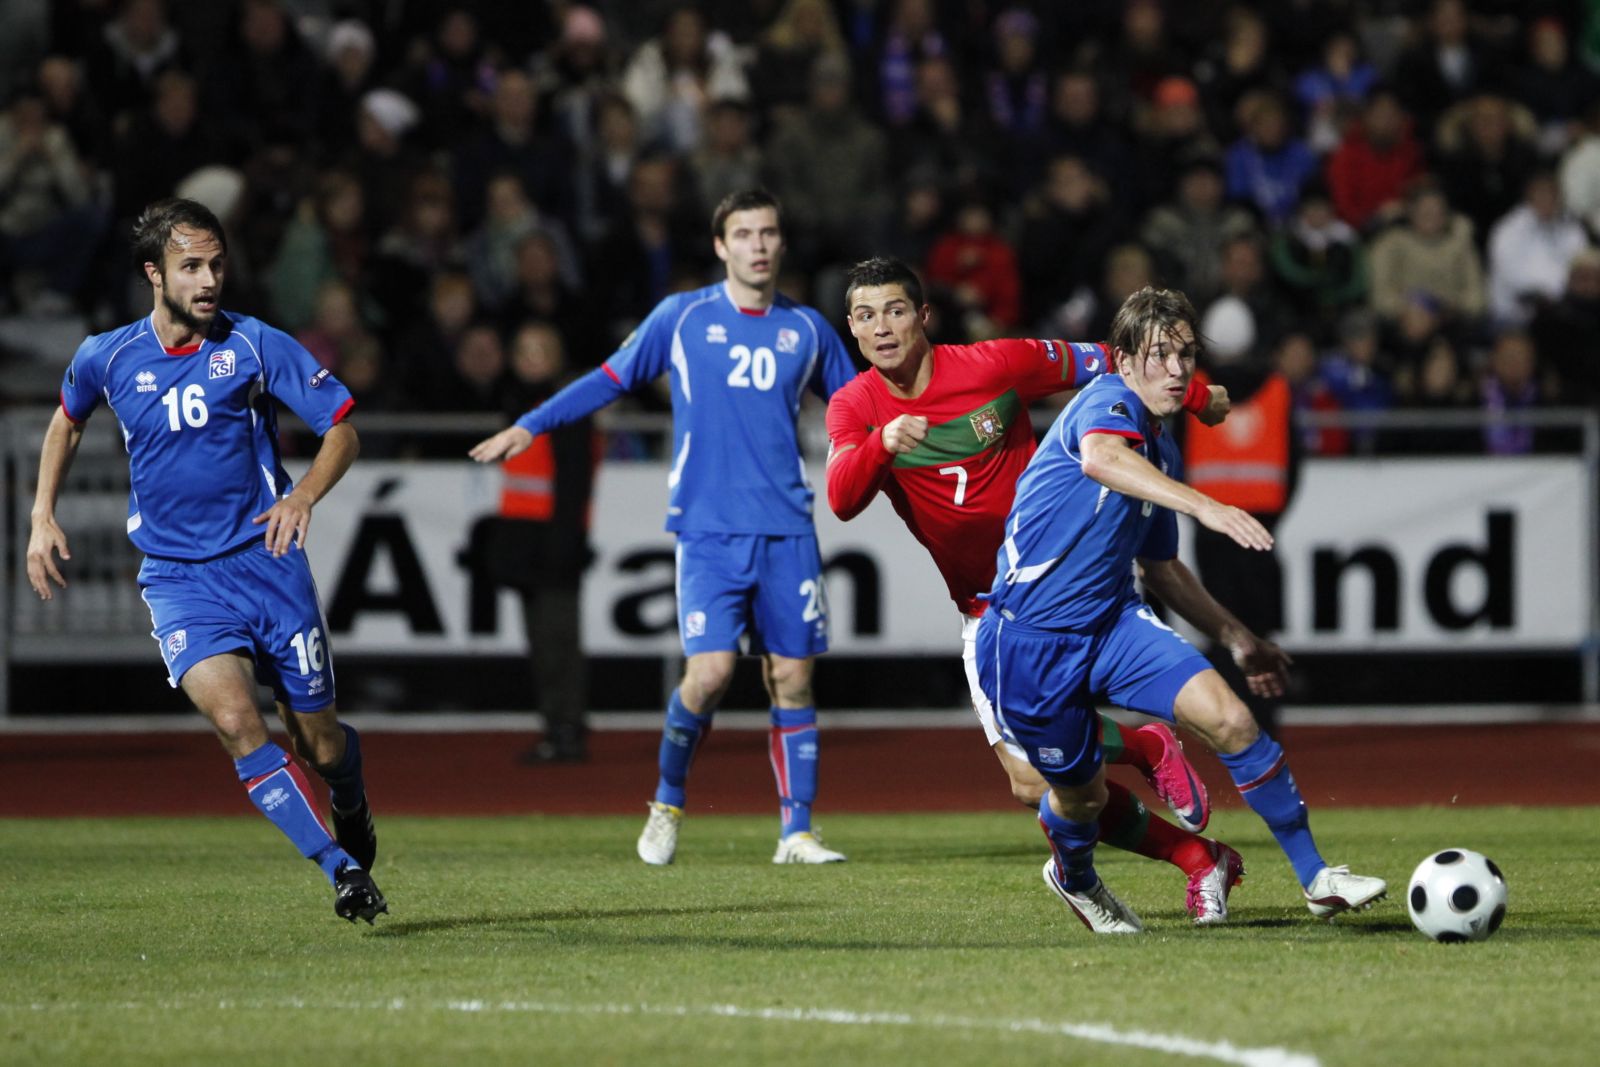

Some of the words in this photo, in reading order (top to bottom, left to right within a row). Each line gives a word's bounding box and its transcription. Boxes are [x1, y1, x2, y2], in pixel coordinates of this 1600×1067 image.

[727, 344, 777, 391] 20
[161, 383, 209, 432] 16
[938, 465, 968, 506] 7
[290, 626, 325, 676] 16
